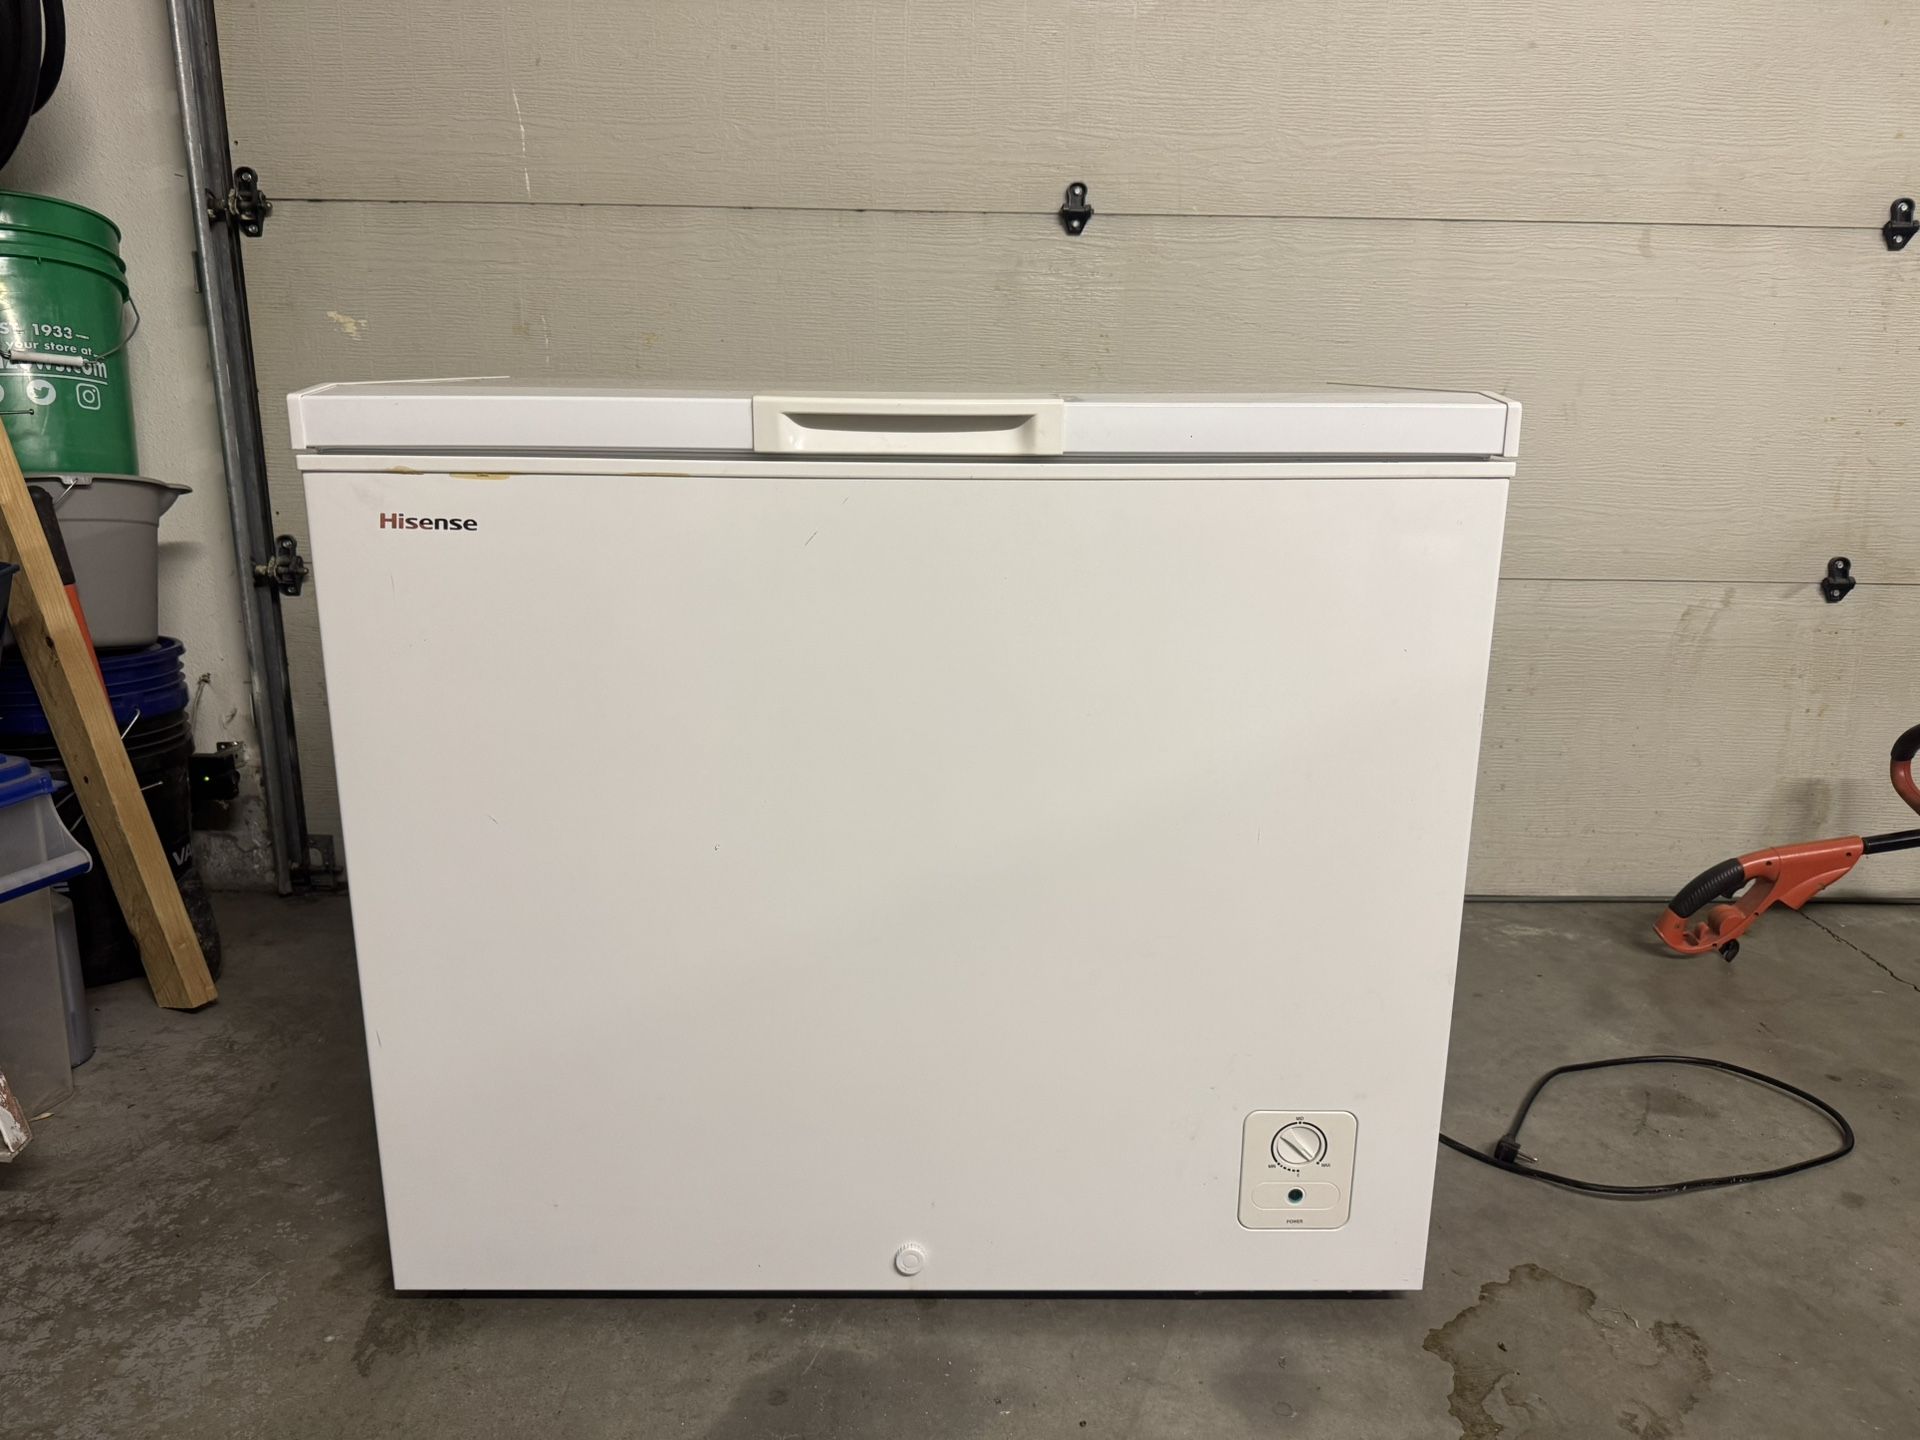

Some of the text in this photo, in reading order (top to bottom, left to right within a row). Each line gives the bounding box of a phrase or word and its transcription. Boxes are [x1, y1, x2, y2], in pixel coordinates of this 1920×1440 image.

[32, 323, 73, 339] 1933
[5, 341, 92, 355] your store at
[379, 512, 478, 531] Hisense
